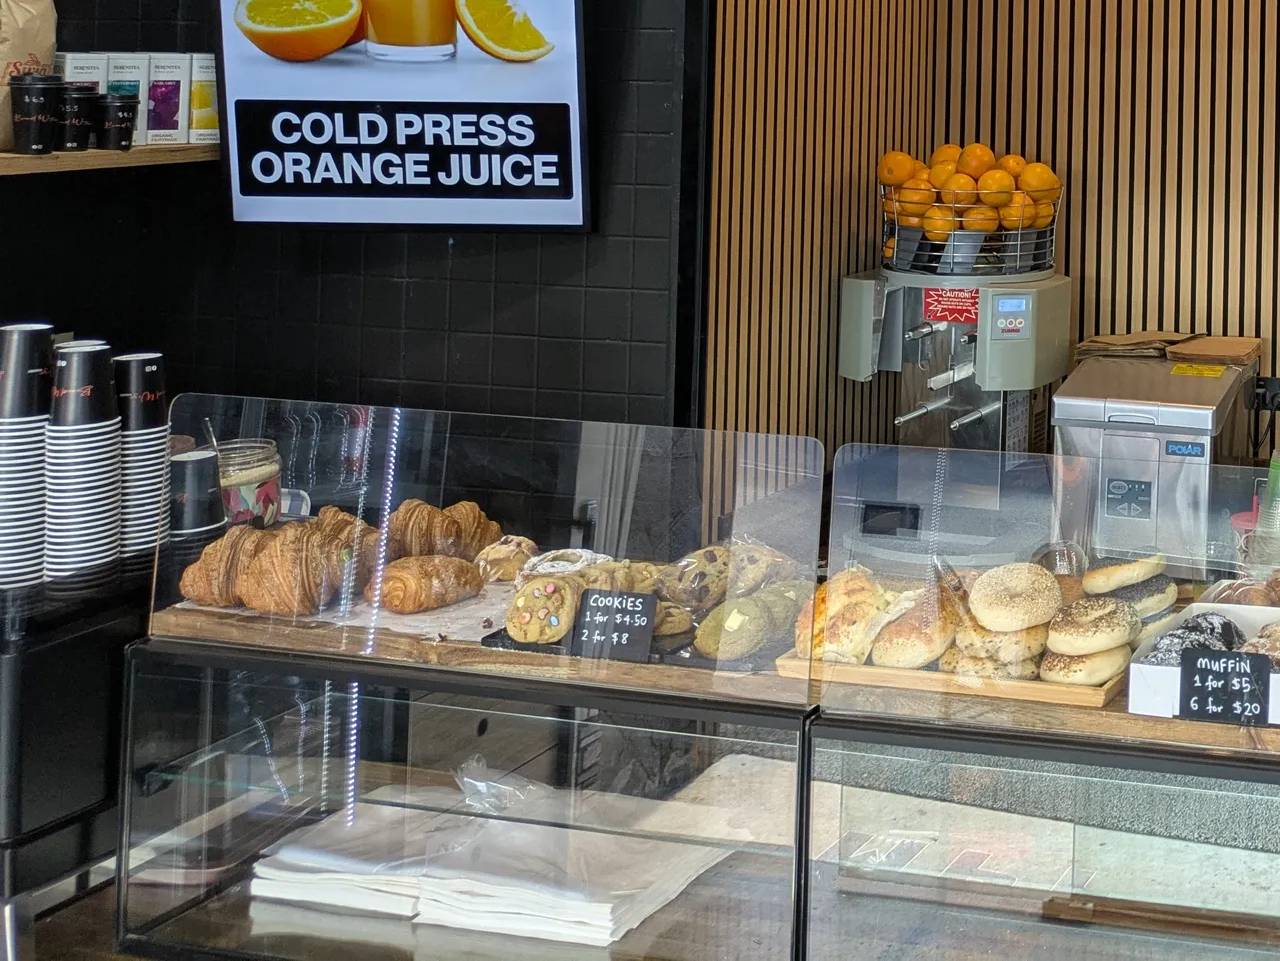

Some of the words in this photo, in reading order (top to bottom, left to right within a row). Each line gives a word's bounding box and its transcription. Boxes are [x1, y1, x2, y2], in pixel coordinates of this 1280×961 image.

[272, 112, 388, 144] COLD
[396, 114, 534, 146] PRESS
[252, 152, 430, 184] ORANGE
[438, 154, 559, 186] JUICE
[1168, 444, 1202, 455] POLAR
[586, 612, 590, 621] 1
[594, 612, 608, 624] for
[615, 614, 648, 626] $4.50
[582, 630, 588, 640] 2
[593, 630, 606, 643] for
[1194, 676, 1202, 686] 1
[1205, 676, 1224, 691] for
[1232, 678, 1250, 692] $5
[1190, 696, 1198, 710] 6
[1206, 698, 1223, 714] for
[1232, 702, 1260, 716] $20
